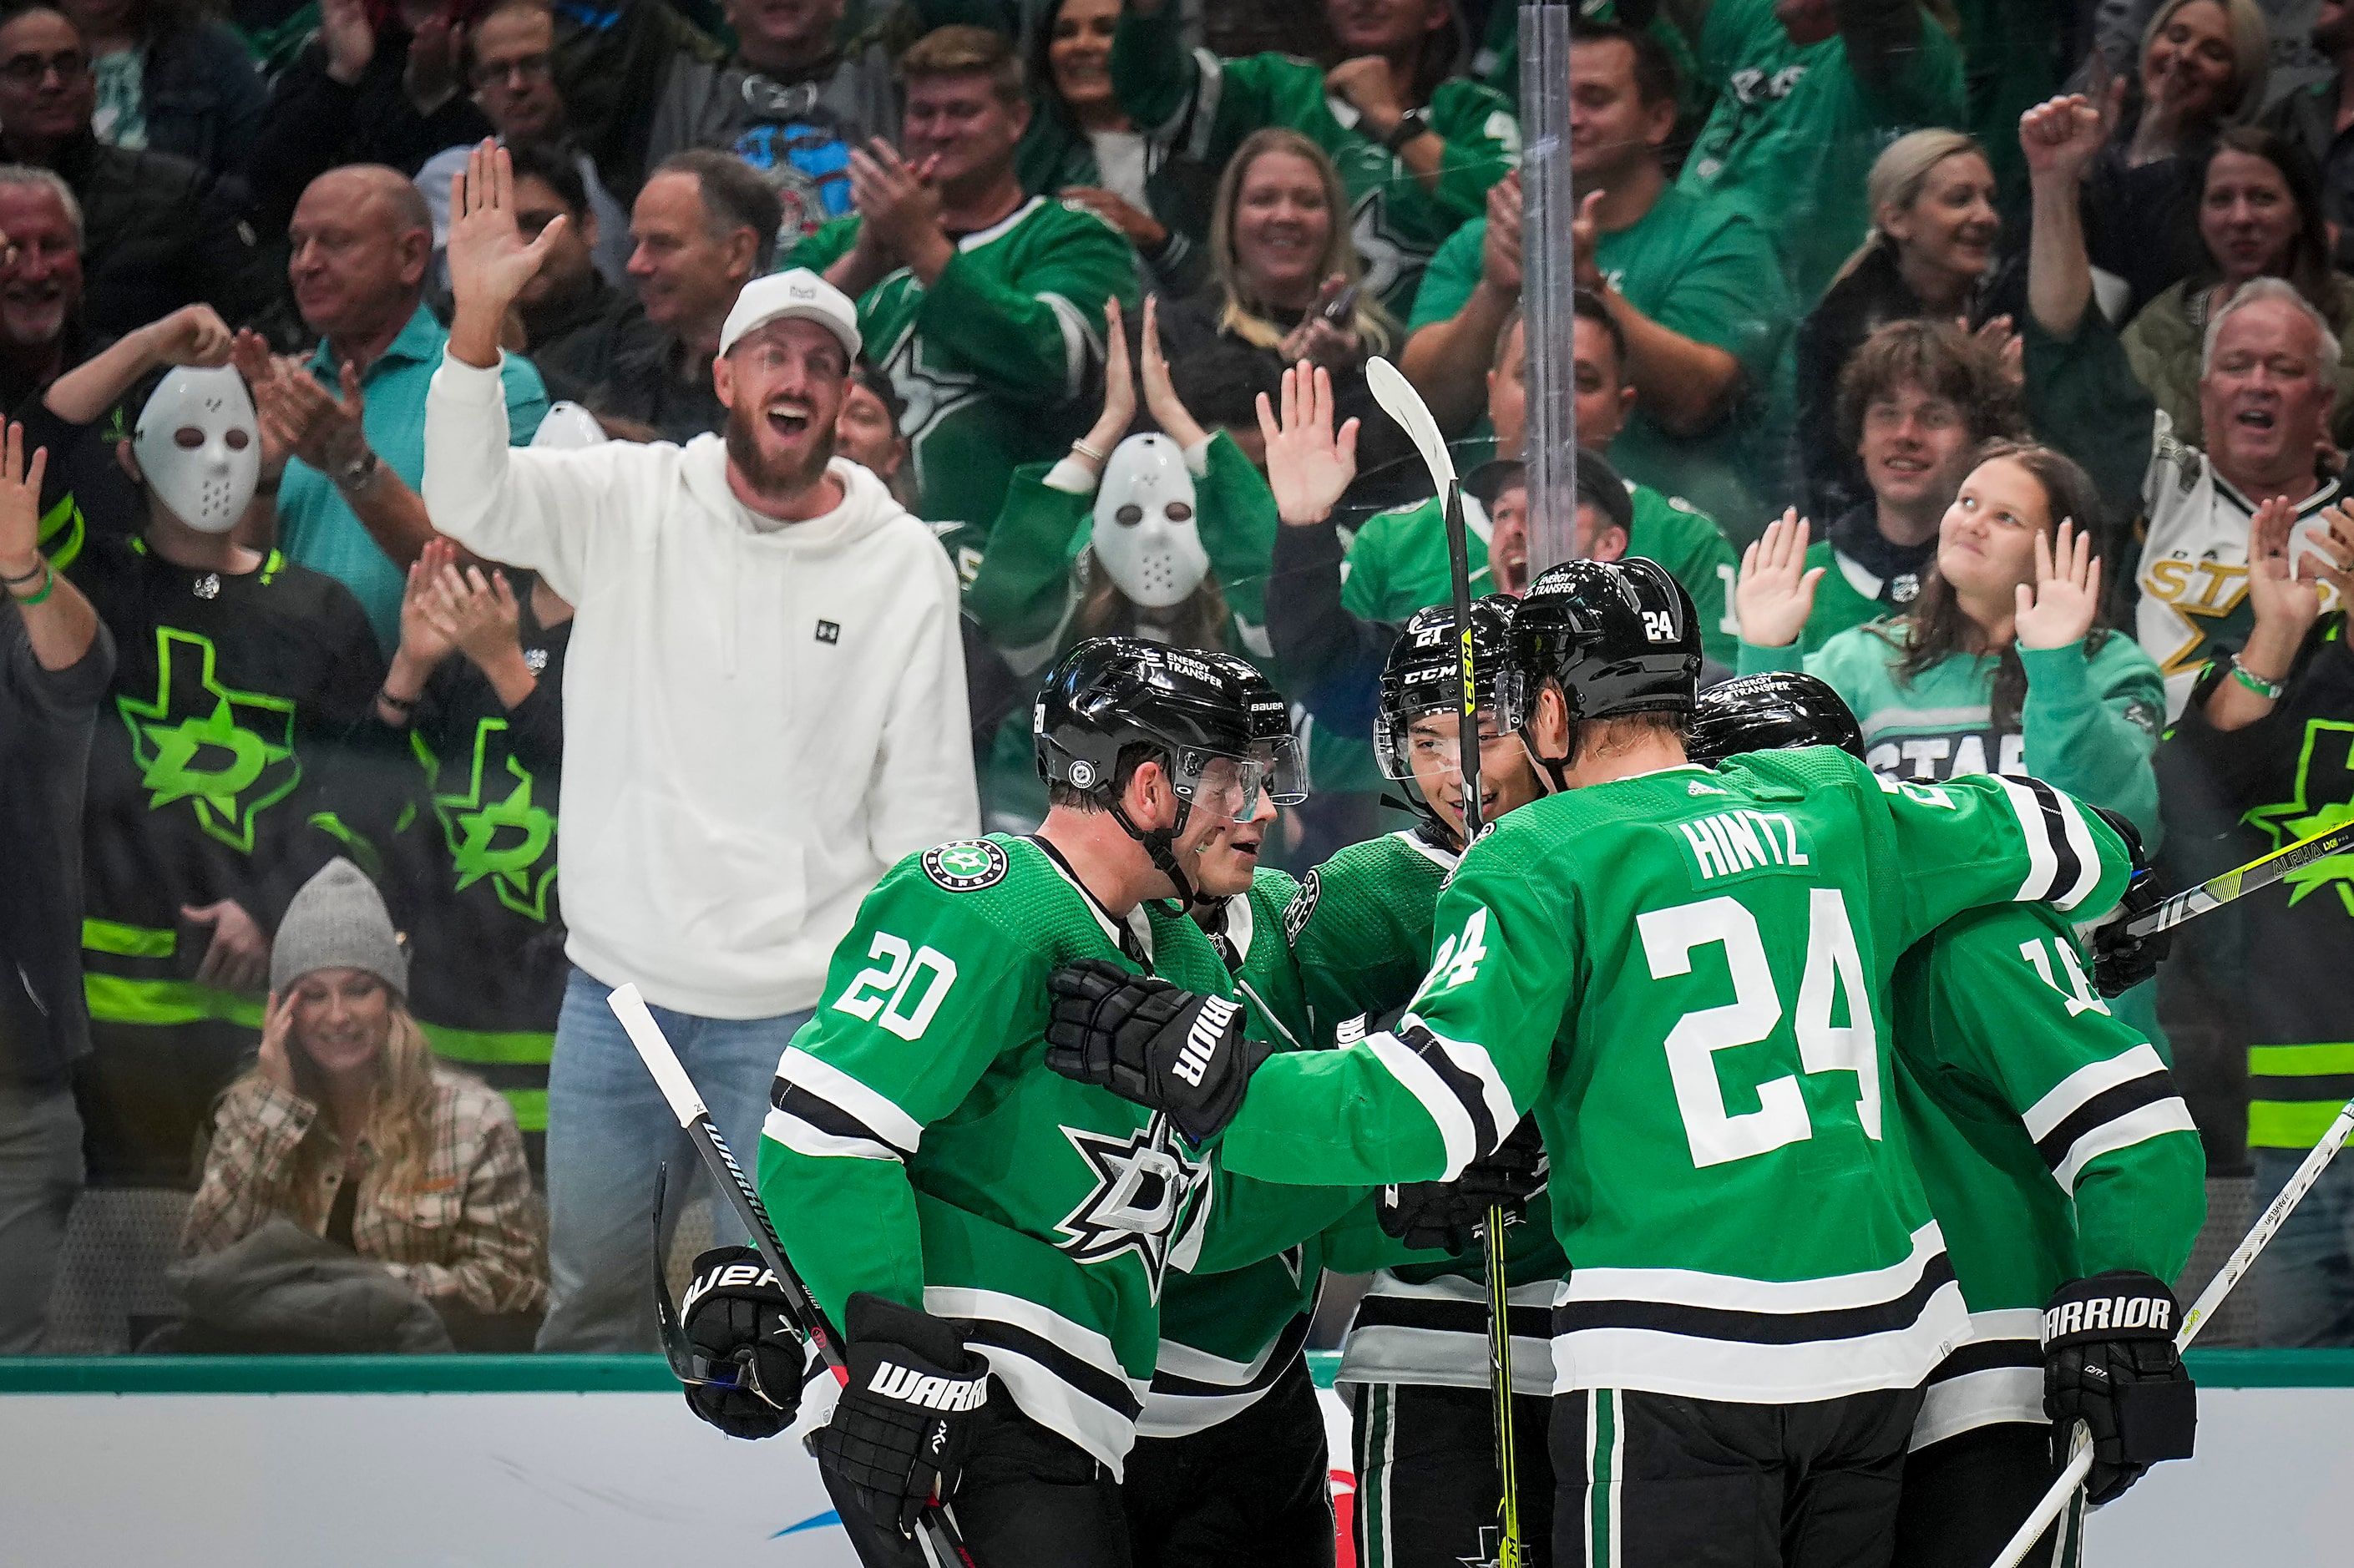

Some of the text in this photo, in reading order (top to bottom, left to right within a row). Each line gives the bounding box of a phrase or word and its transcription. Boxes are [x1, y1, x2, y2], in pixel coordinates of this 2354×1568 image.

[1535, 583, 1577, 596] TRANSFER
[1539, 573, 1572, 586] ENERGY
[1642, 611, 1675, 640] 24
[1167, 651, 1211, 673] ENERGY
[1167, 660, 1223, 690] TRANSFER
[1405, 665, 1458, 684] CCM
[1463, 641, 1475, 706] CCM
[1727, 676, 1772, 691] ENERGY
[1732, 680, 1792, 697] TRANSFER
[1678, 810, 1810, 880] HINTZ
[2272, 842, 2326, 878] ALPHA
[1405, 905, 1487, 1014] 24
[832, 931, 958, 1041] 20
[1637, 888, 1882, 1168] 24
[2044, 1296, 2171, 1345] ARRIOR
